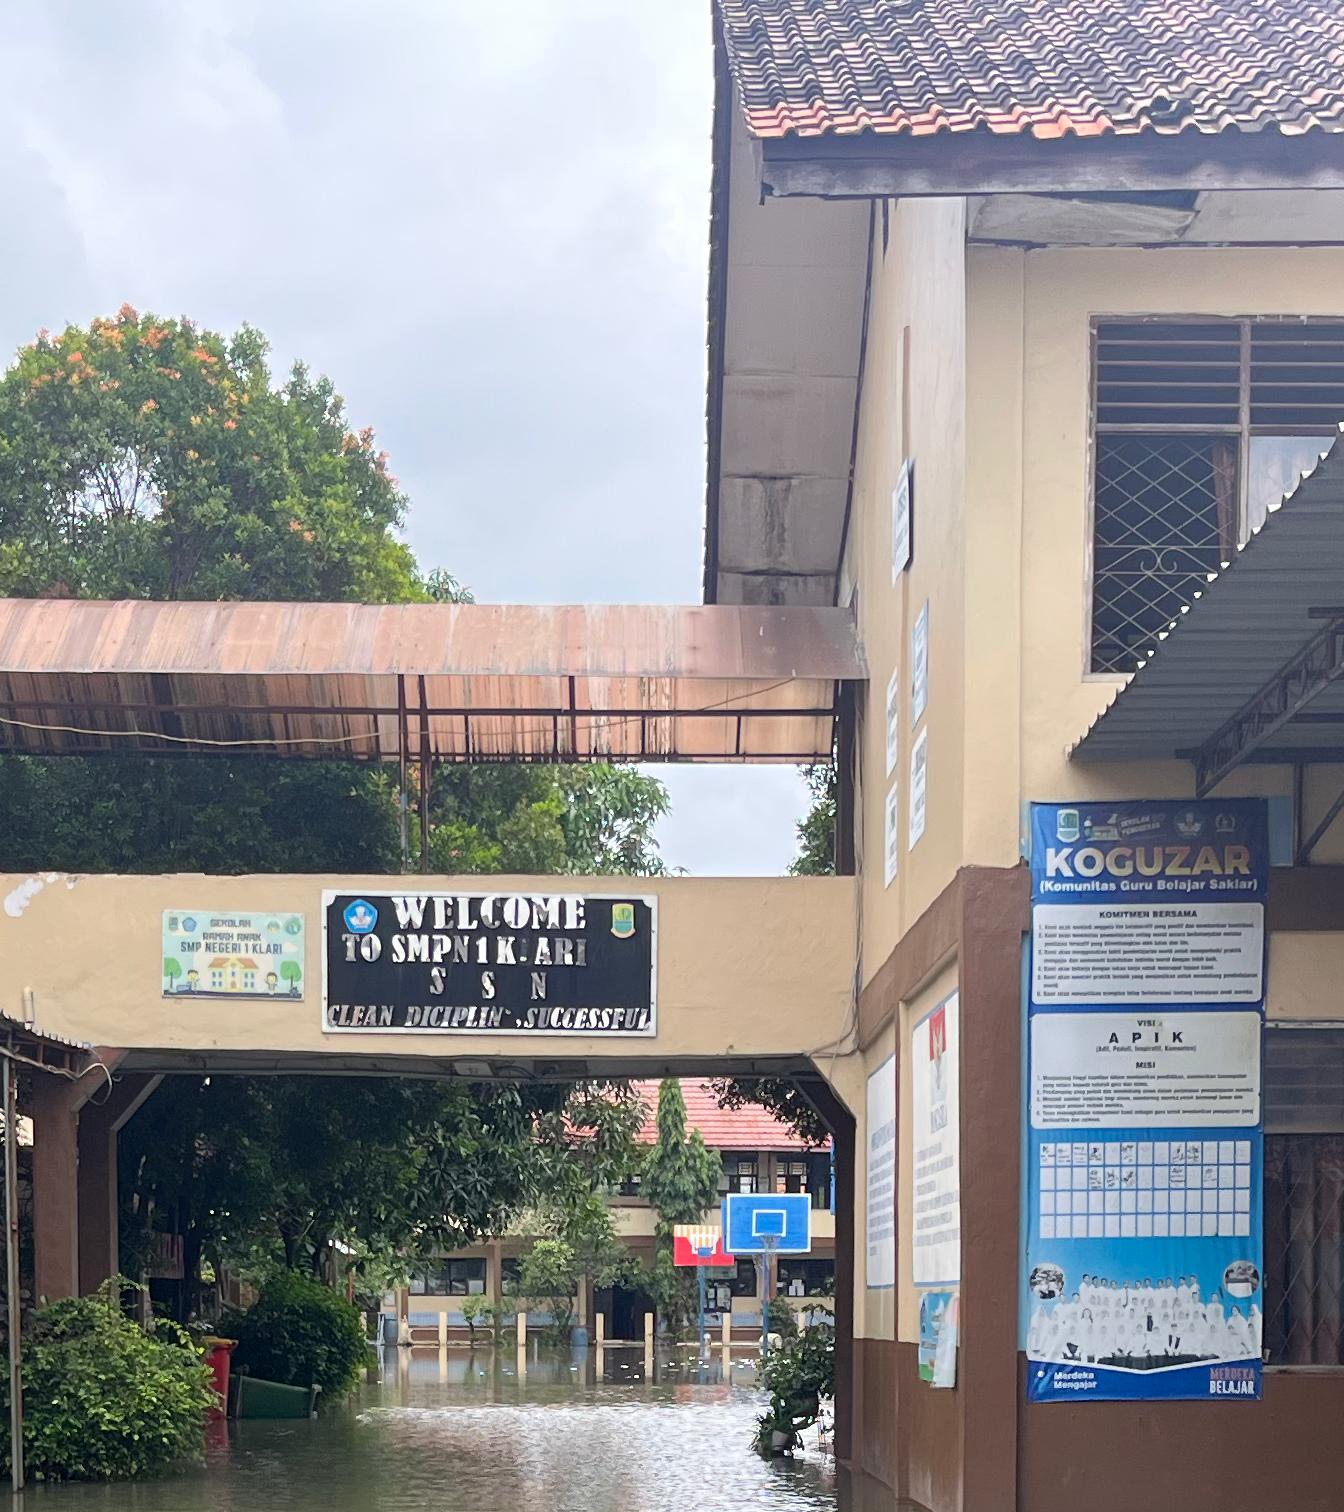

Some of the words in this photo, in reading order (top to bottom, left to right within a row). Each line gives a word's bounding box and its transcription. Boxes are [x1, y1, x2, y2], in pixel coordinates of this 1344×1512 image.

[1045, 845, 1251, 877] KOGUZAR
[1039, 880, 1117, 893] (Komunitas
[1120, 880, 1153, 892] Guru
[1157, 879, 1206, 893] Belajar
[391, 896, 586, 930] WELCOME
[1099, 911, 1150, 919] KOMITMEN
[1153, 910, 1198, 918] BERSAMA
[237, 933, 262, 941] ANAK
[180, 941, 201, 953] SMP
[205, 942, 241, 953] NEGERI
[252, 943, 282, 955] KLARI
[342, 933, 382, 962] TO
[391, 933, 469, 965] SMPN
[429, 967, 447, 995] S
[481, 970, 496, 1000] S
[530, 972, 547, 1001] N
[328, 1004, 395, 1027] CLEAN
[1136, 1061, 1156, 1069] MISI
[1054, 1371, 1095, 1380] Merdeka
[1054, 1380, 1098, 1391] Mengajar
[1210, 1380, 1255, 1394] BELAJAR
